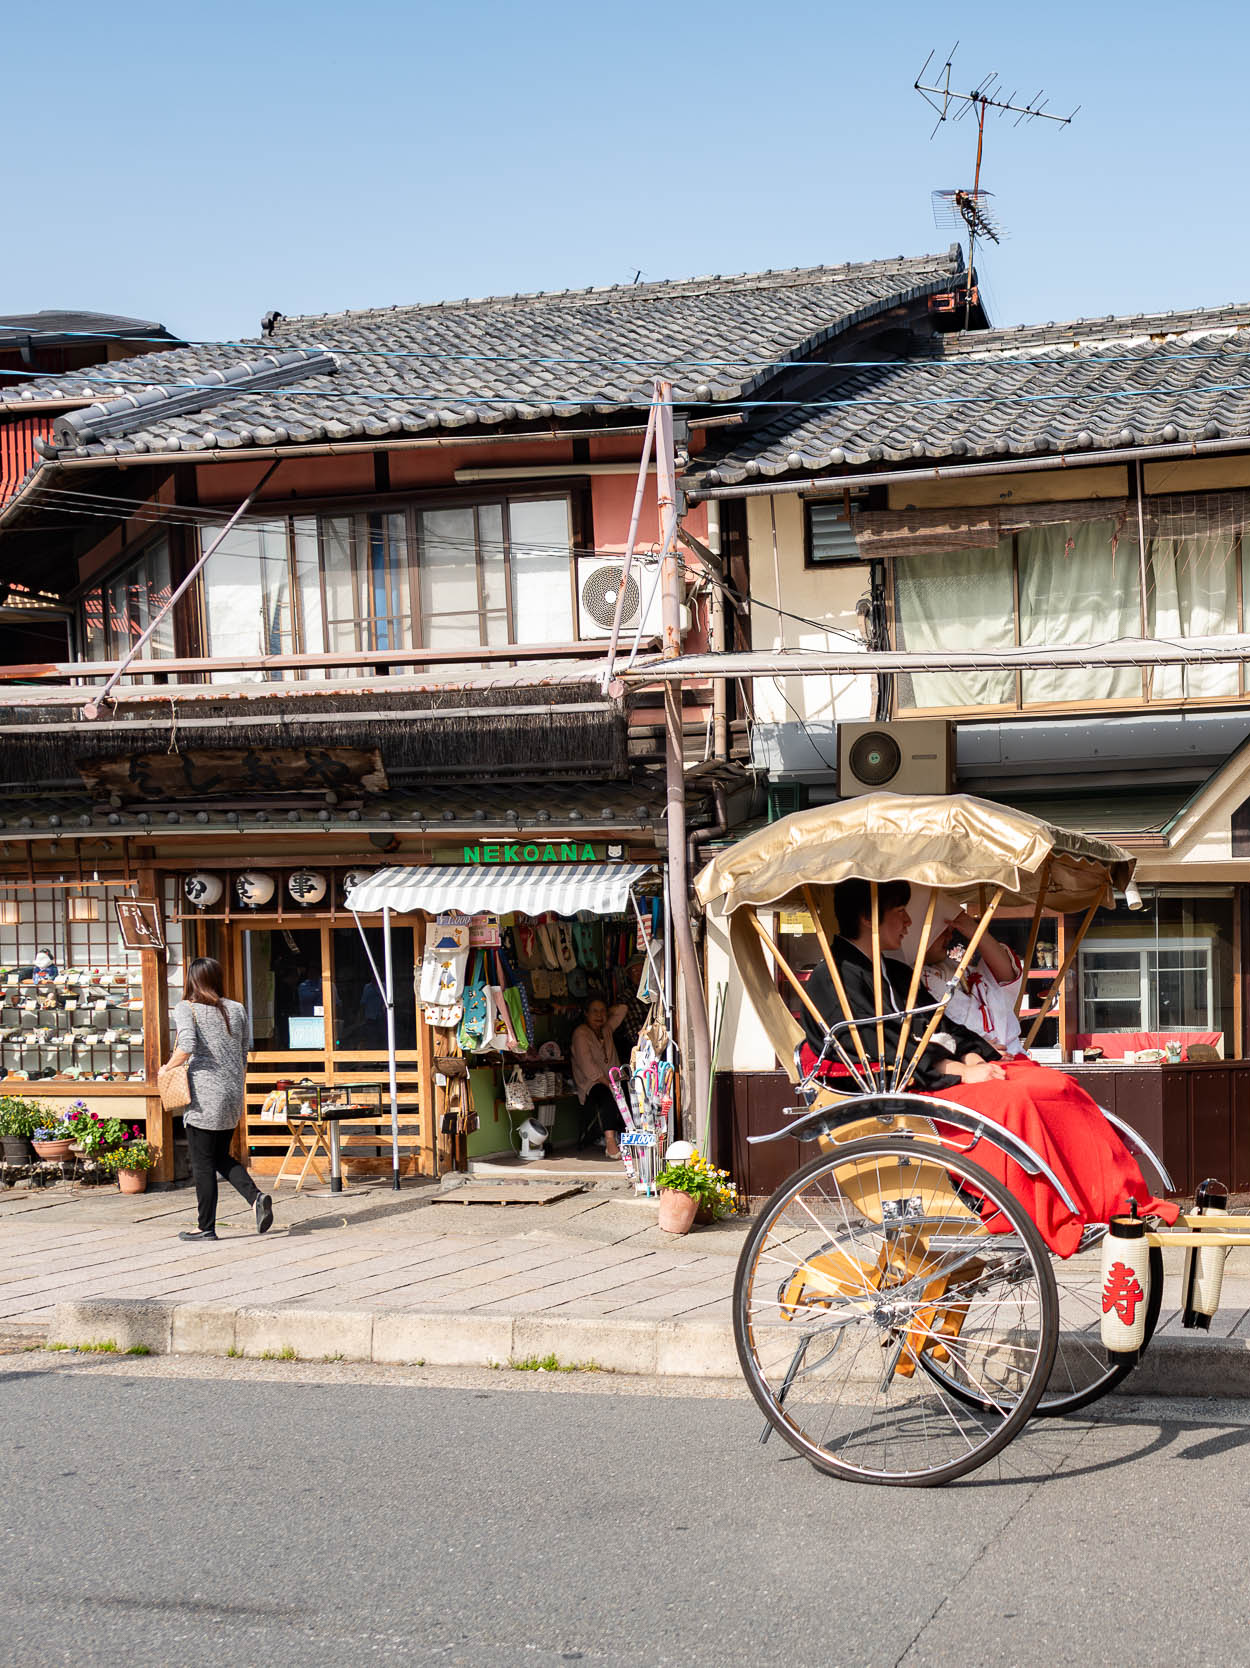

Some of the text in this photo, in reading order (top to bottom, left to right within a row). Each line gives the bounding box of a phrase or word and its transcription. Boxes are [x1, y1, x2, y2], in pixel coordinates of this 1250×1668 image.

[464, 843, 597, 864] NEKOANA
[622, 1135, 655, 1145] ¥1,000
[1102, 1261, 1144, 1326] 寿
